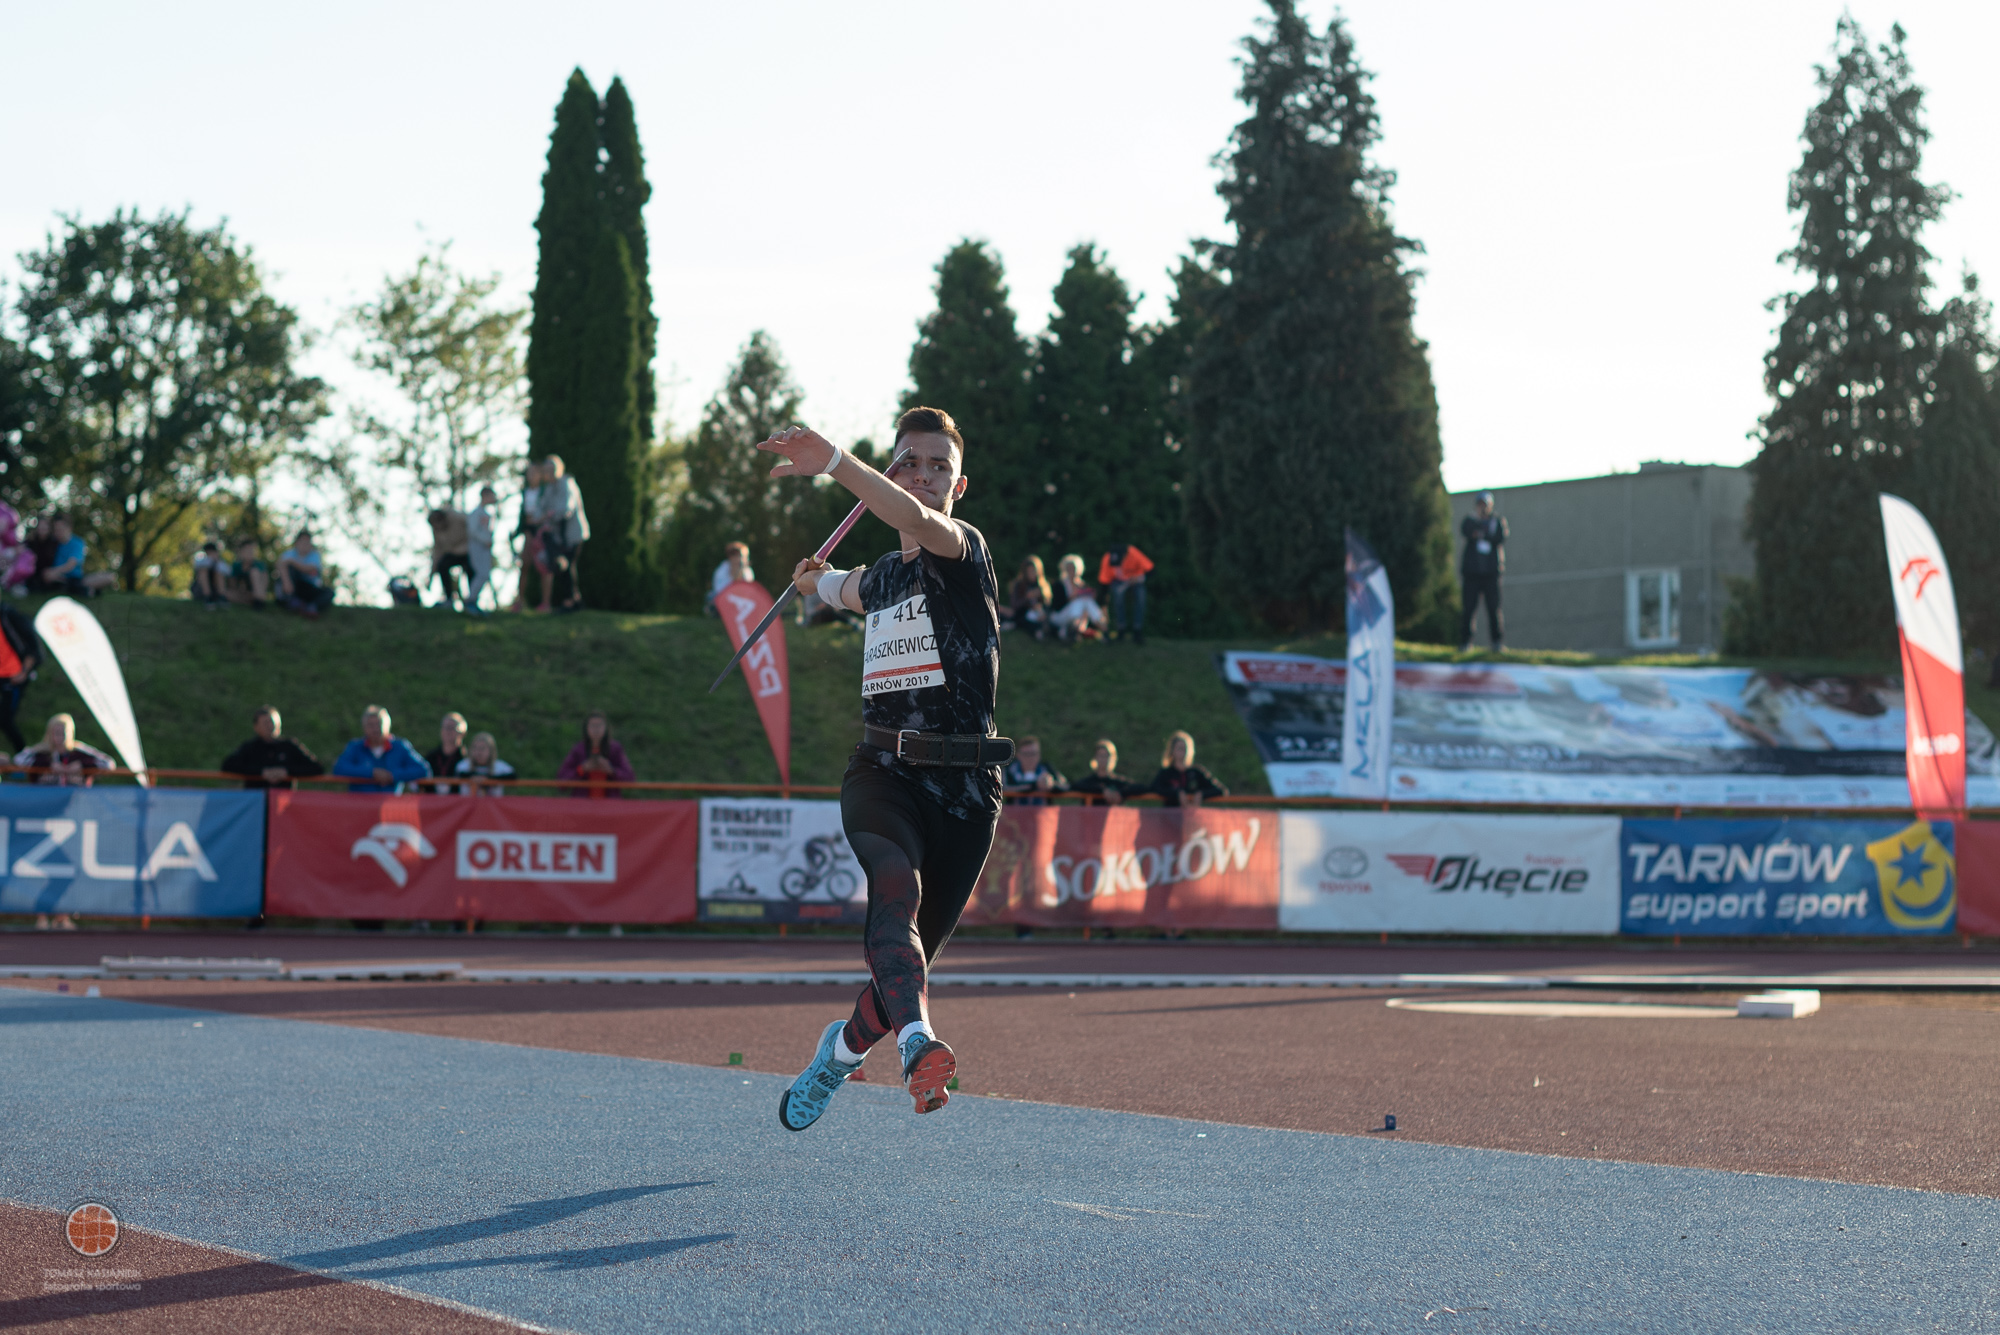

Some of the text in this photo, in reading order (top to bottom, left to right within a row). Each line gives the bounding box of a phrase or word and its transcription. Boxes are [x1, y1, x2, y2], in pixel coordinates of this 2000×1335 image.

[893, 598, 931, 622] 414
[905, 675, 930, 687] 2019
[468, 839, 605, 873] ORLEN
[1041, 817, 1261, 907] SOKOŁÓW
[1627, 839, 1853, 883] TARNÓW
[1319, 880, 1373, 894] TOYOTA
[1626, 888, 1869, 925] support sport
